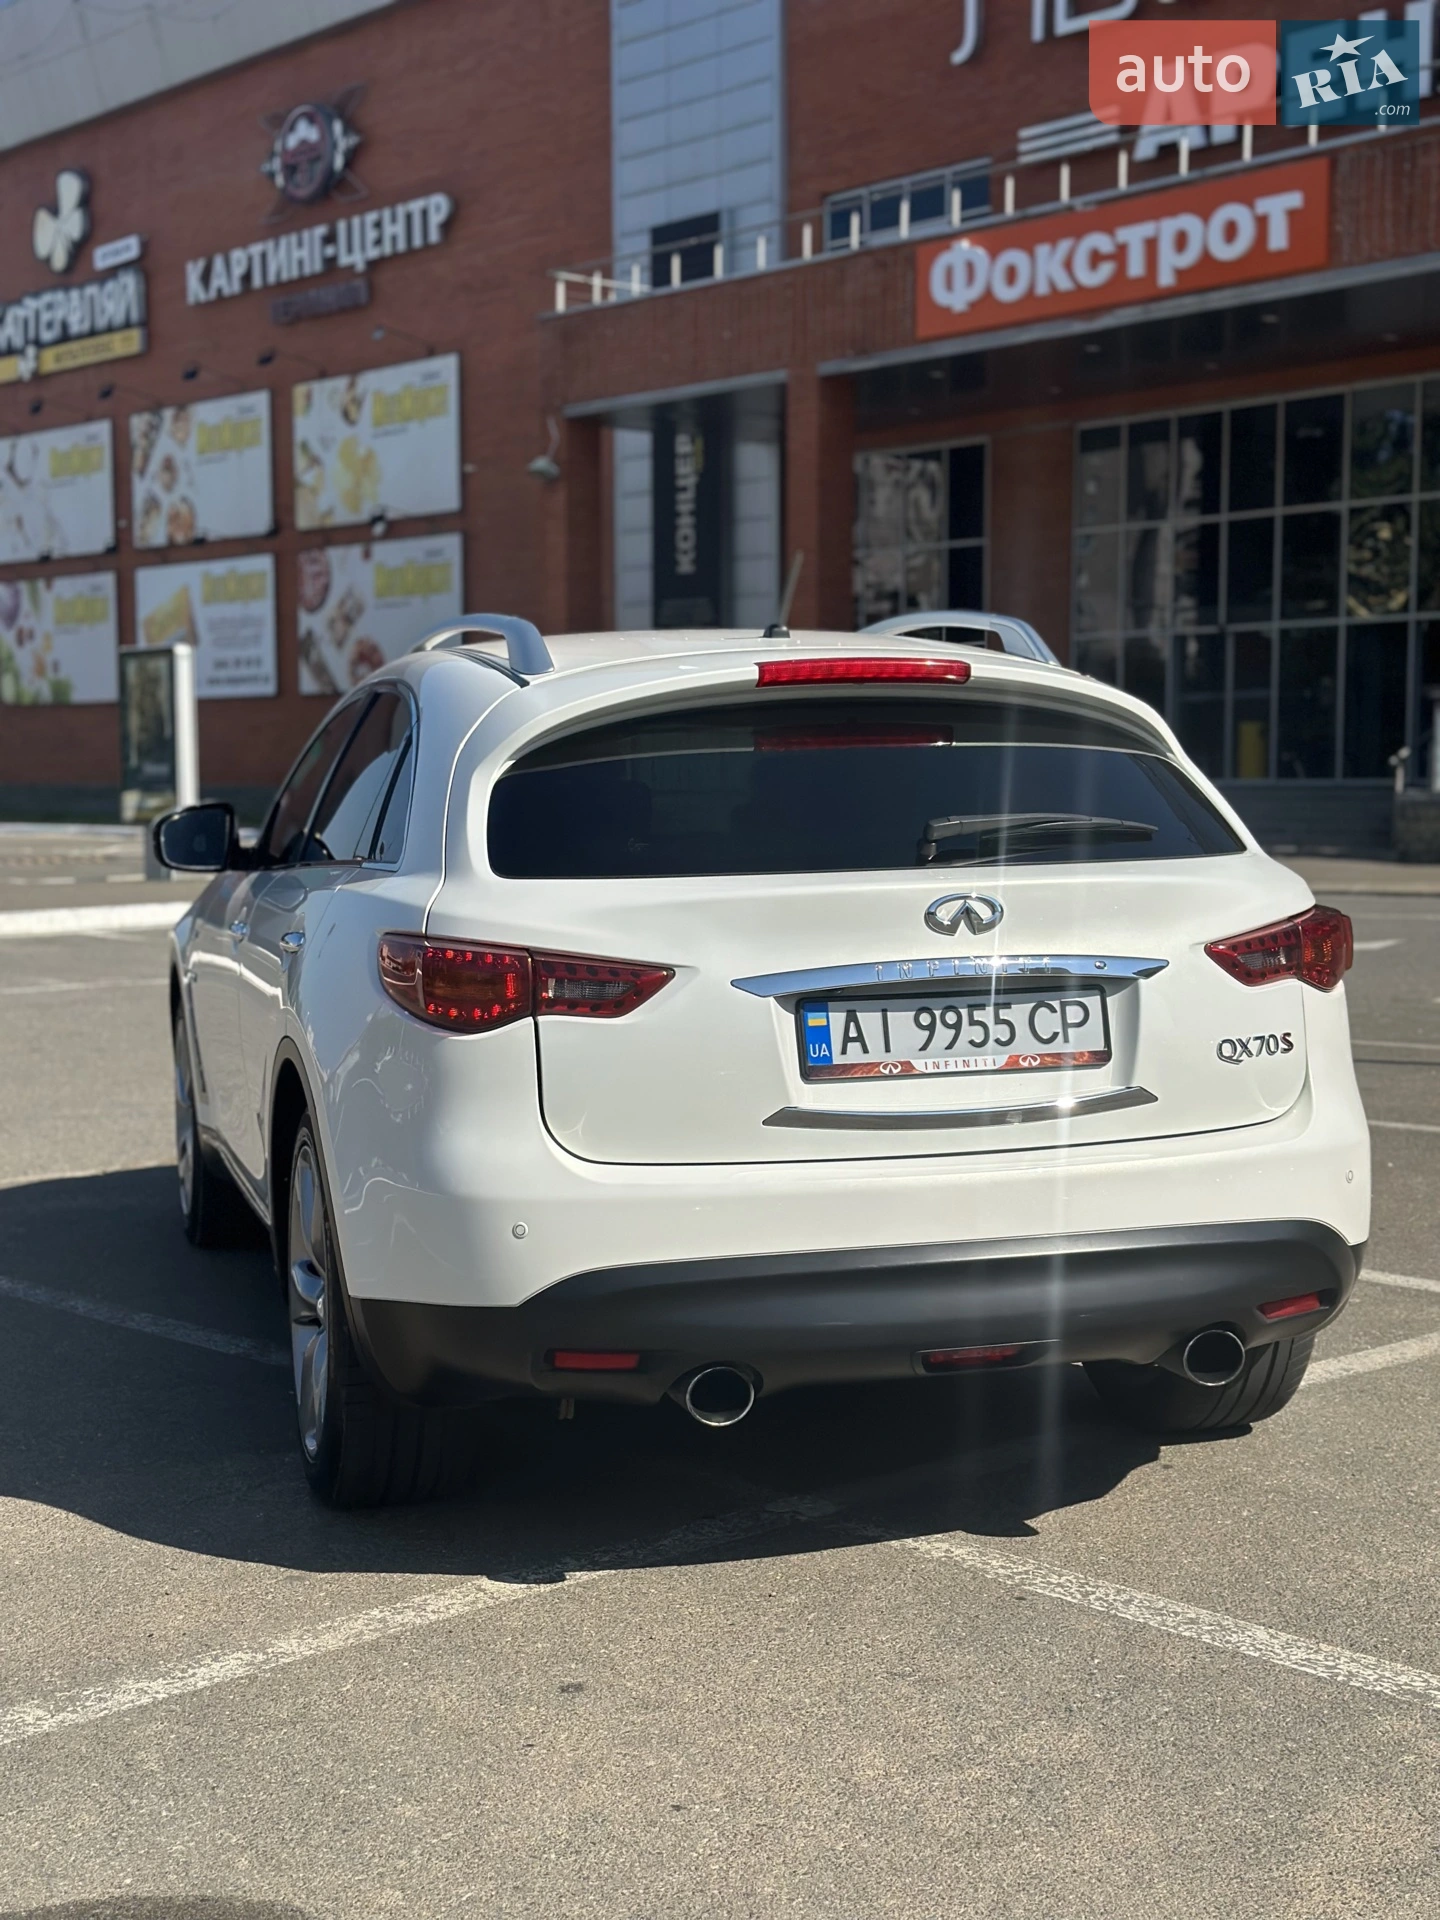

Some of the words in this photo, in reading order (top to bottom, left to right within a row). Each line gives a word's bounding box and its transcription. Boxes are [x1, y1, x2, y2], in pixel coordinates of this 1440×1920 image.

[1133, 0, 1440, 162] АРЕН
[185, 192, 454, 305] КАРТИНГ-ЦЕНТР
[929, 191, 1305, 313] Фокстрот
[674, 430, 700, 575] АТЕРАЛЯЙ
[874, 956, 1051, 981] INFINITI
[809, 1043, 830, 1058] UA
[841, 1008, 891, 1056] AI
[913, 1002, 1017, 1052] 9955
[1028, 998, 1091, 1046] CP
[923, 1057, 998, 1071] INFINITI
